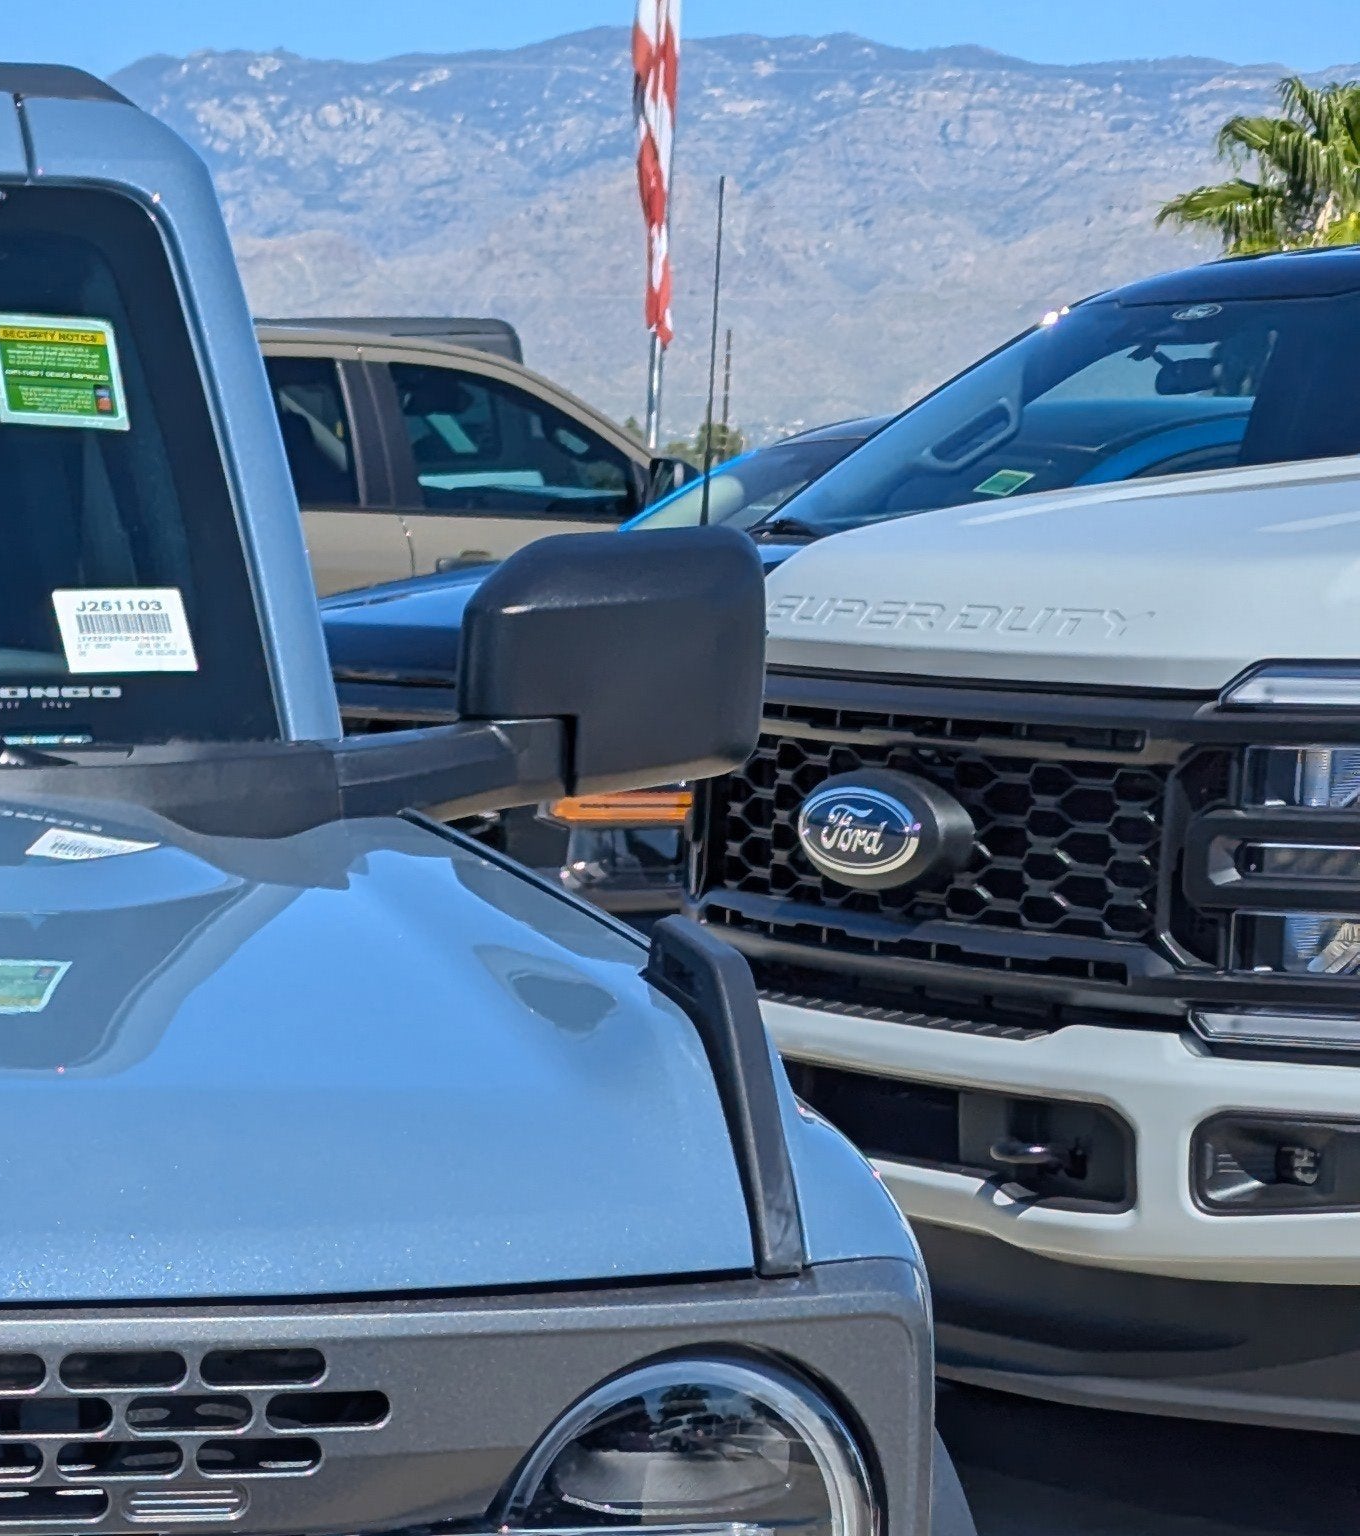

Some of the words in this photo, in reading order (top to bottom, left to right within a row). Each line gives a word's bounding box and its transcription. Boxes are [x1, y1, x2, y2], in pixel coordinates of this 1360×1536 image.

[766, 594, 945, 631] SUPER
[946, 603, 1156, 639] DUTY
[821, 803, 888, 856] Ford
